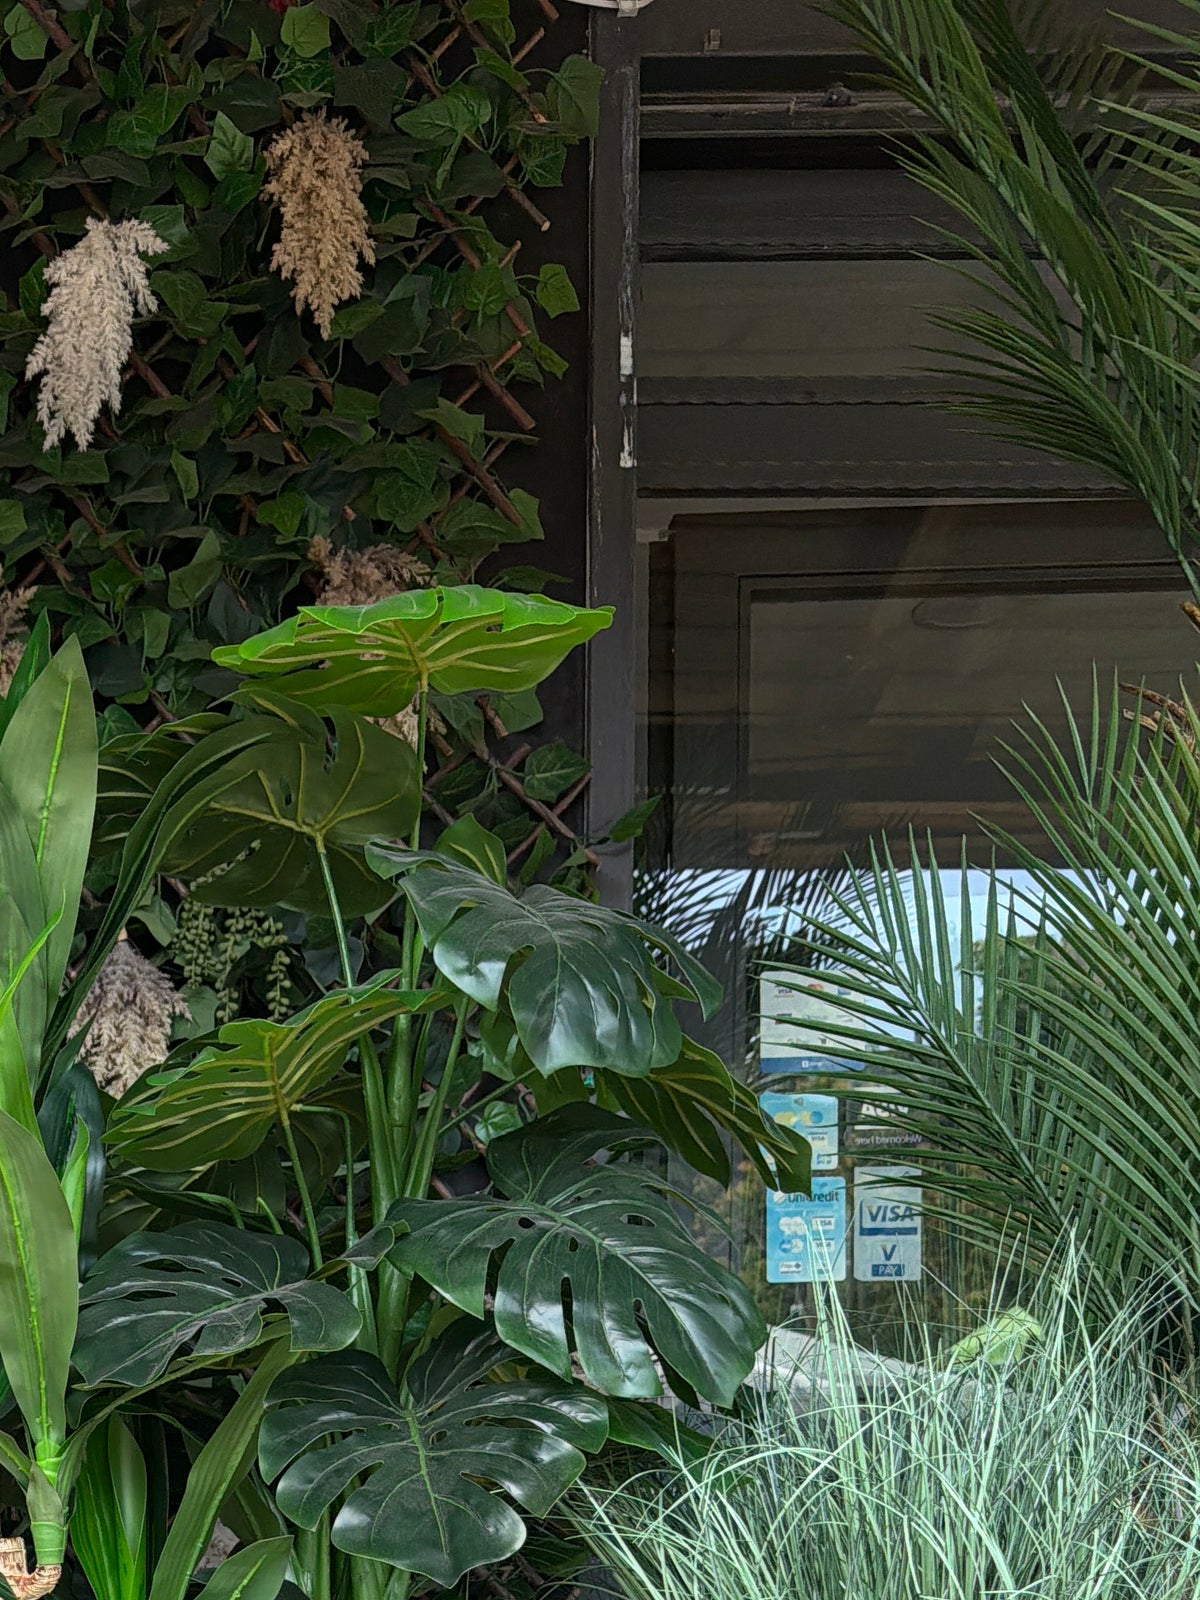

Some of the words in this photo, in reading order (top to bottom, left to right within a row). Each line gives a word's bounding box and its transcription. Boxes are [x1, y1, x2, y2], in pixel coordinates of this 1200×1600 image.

[788, 1191, 840, 1203] Uniredit
[868, 1205, 914, 1222] VISA
[881, 1243, 897, 1261] V
[879, 1264, 899, 1277] PAY
